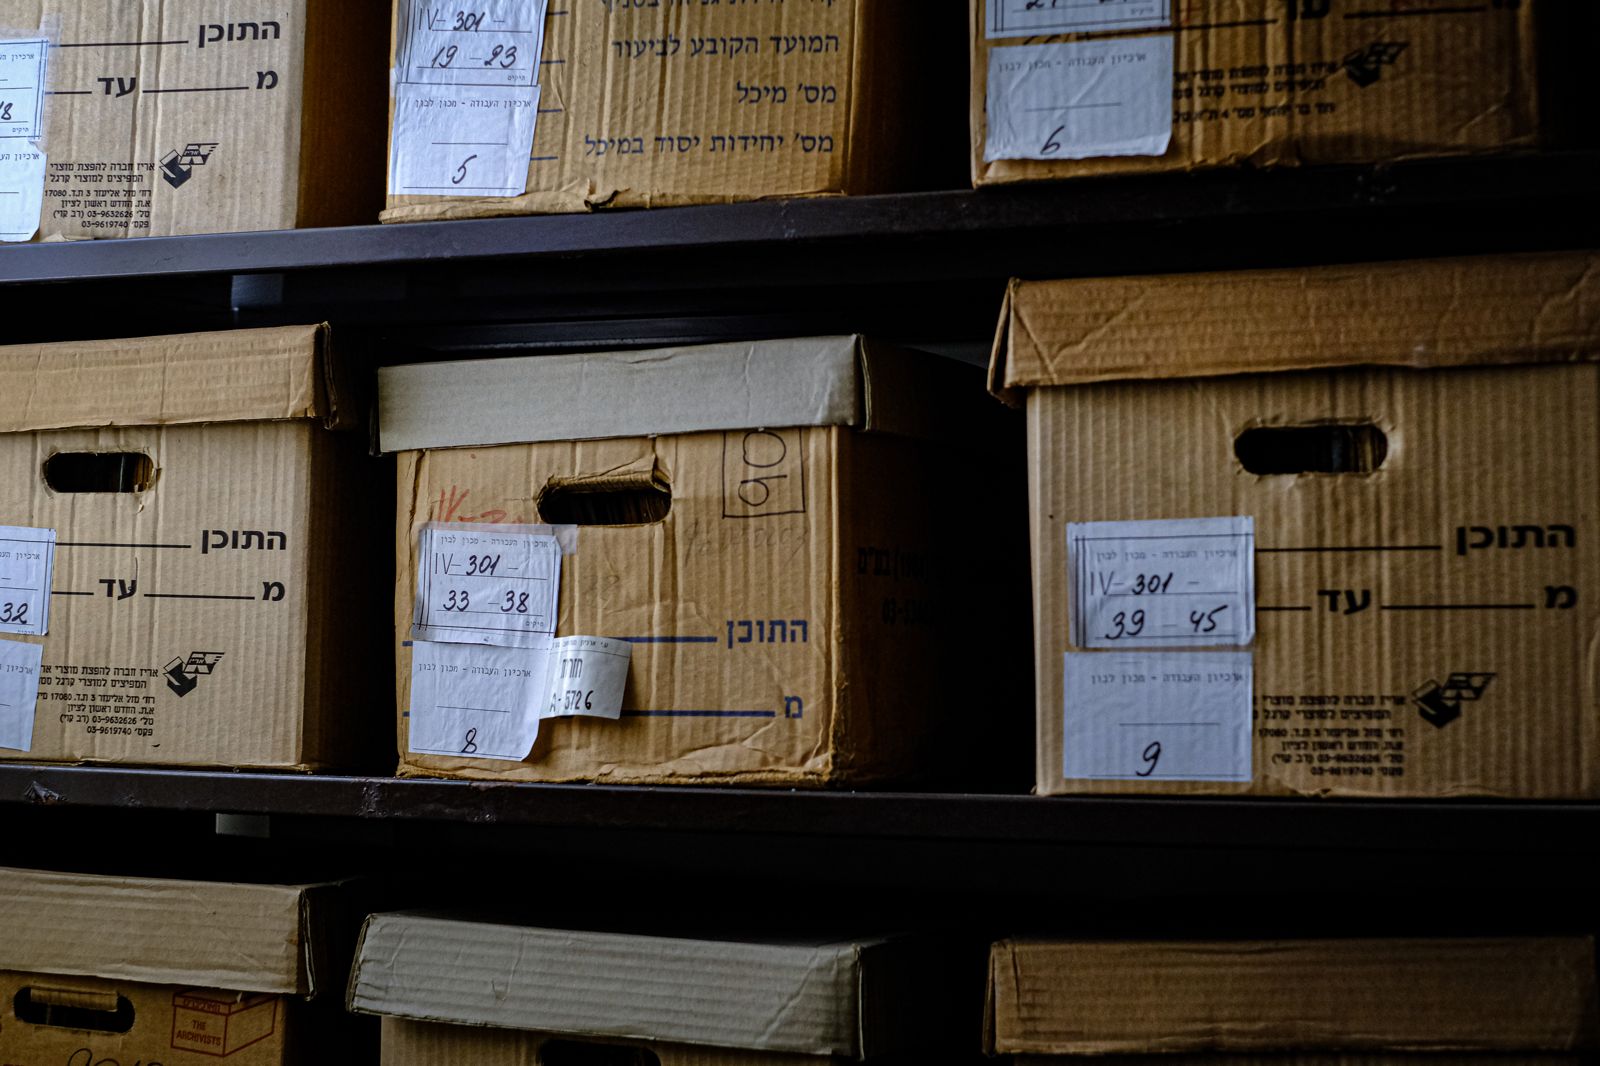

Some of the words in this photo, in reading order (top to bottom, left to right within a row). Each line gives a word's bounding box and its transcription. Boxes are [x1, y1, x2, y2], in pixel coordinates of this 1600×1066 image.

[453, 11, 485, 32] 301
[198, 21, 280, 48] התוכן
[612, 35, 680, 59] לביעור
[691, 37, 758, 59] הקובע
[770, 36, 839, 55] המועד
[432, 45, 458, 69] 19
[484, 44, 517, 68] 23
[97, 76, 136, 98] עד
[257, 70, 278, 90] מ
[737, 81, 786, 103] מיכל
[415, 98, 434, 107] לבון
[439, 99, 457, 108] מכון
[470, 99, 499, 108] העבודה
[504, 100, 531, 108] ארכיון
[585, 134, 643, 156] במיכל
[655, 135, 700, 154] יסוד
[710, 135, 784, 154] יחידות
[1040, 126, 1064, 155] 6
[50, 163, 74, 171] מוצרי
[77, 162, 107, 171] להפצת
[110, 163, 133, 171] חברה
[137, 163, 155, 171] אריז
[452, 155, 477, 184] 5
[50, 174, 71, 184] קרגל
[74, 174, 103, 183] למוצרי
[107, 174, 144, 183] המפיצים
[61, 200, 81, 209] לציון
[84, 200, 107, 209] ראשון
[202, 529, 287, 554] התוכן
[1457, 524, 1575, 555] התוכן
[466, 554, 500, 576] 301
[99, 578, 137, 600] עד
[1132, 572, 1173, 595] 301
[262, 581, 285, 601] מ
[1544, 585, 1576, 609] מ
[443, 590, 469, 612] 33
[501, 590, 529, 613] 38
[1317, 589, 1371, 615] עד
[1106, 610, 1145, 639] 39
[1190, 605, 1228, 632] 45
[727, 620, 808, 649] התוכן
[55, 666, 78, 675] מוצרי
[81, 666, 110, 676] להפצת
[114, 667, 136, 677] חברה
[140, 668, 158, 677] אריז
[418, 663, 436, 672] לבון
[441, 665, 458, 673] מכון
[471, 667, 499, 676] העבודה
[504, 668, 531, 677] ארכיון
[56, 677, 75, 687] קרגל
[79, 678, 107, 687] למוצרי
[111, 679, 147, 688] המפיצים
[91, 694, 96, 702] 3
[68, 704, 86, 713] לציון
[89, 705, 111, 714] ראשון
[784, 695, 803, 718] מ
[87, 726, 131, 736] 03-9619740
[461, 727, 477, 753] 8
[1136, 741, 1161, 777] 9
[192, 1019, 206, 1031] THE
[176, 1029, 222, 1046] ARCHIVISTS
